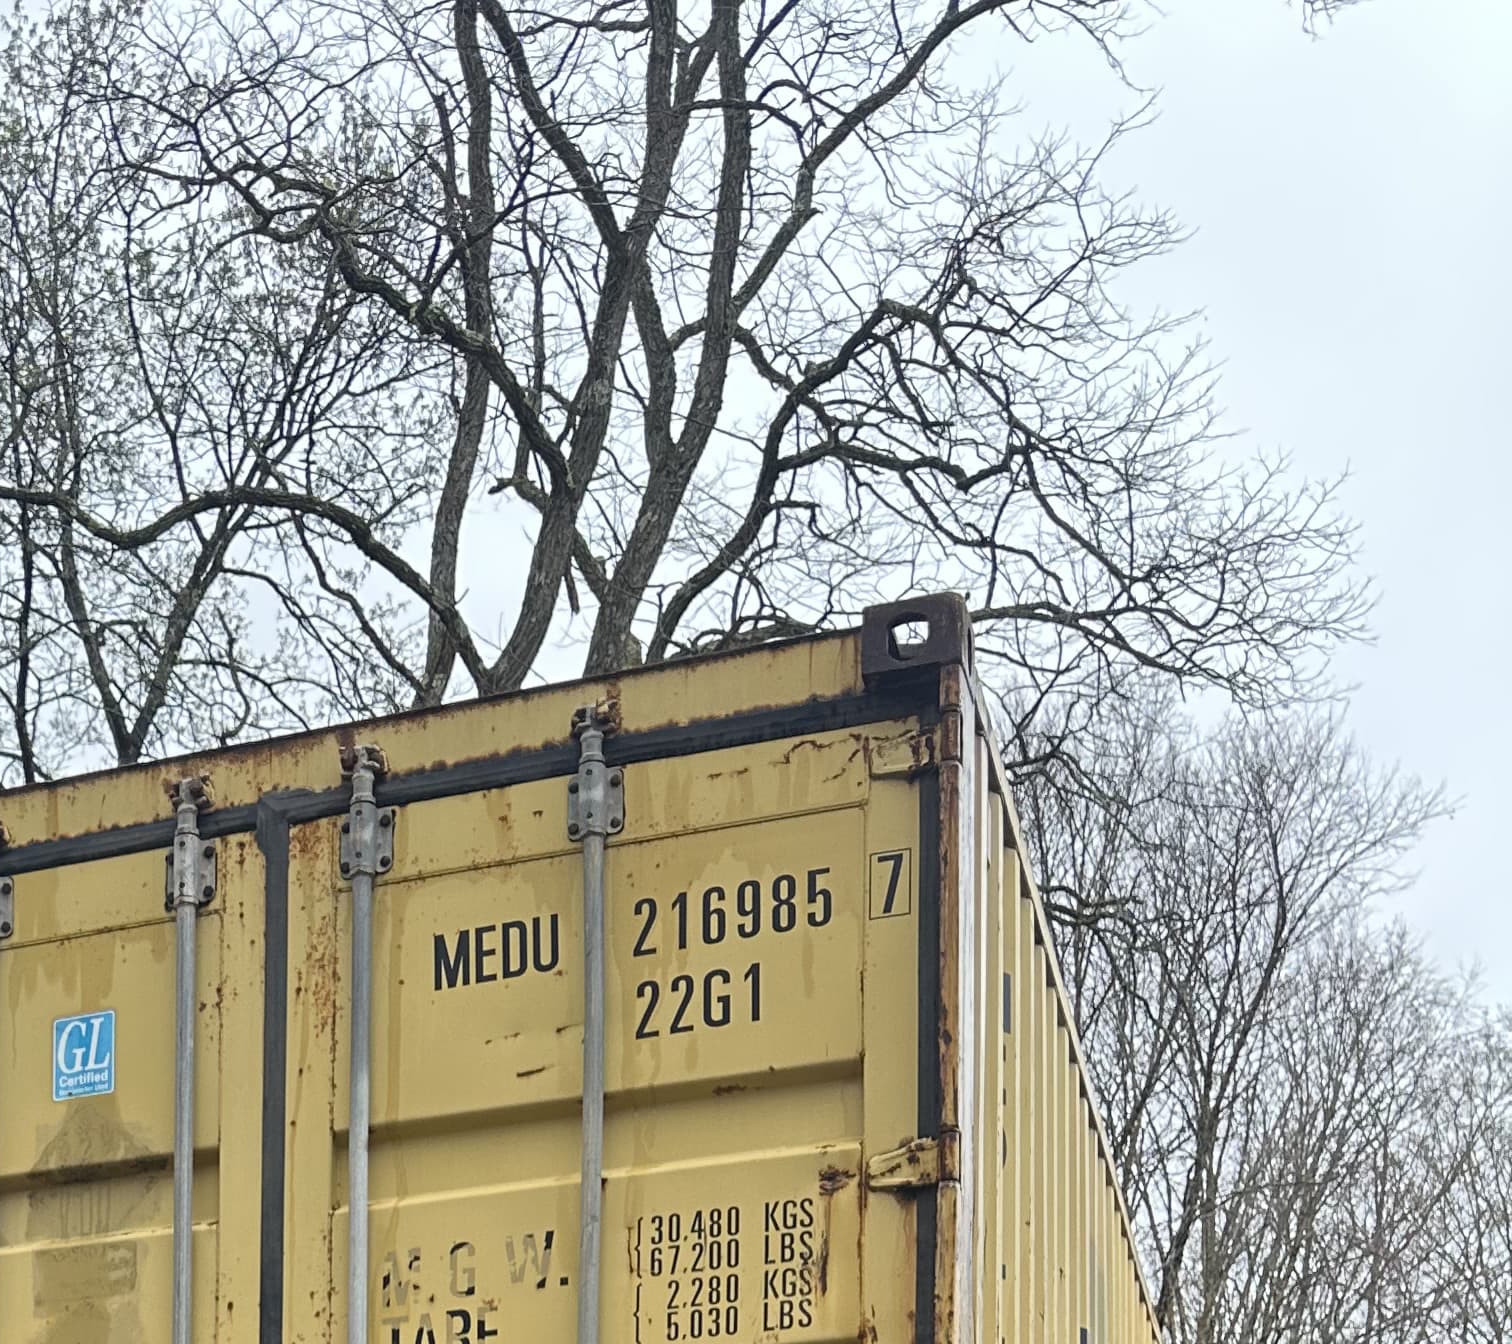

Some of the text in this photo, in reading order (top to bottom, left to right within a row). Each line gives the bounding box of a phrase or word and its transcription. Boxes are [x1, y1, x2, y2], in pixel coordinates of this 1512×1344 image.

[433, 853, 904, 991] MEDU 216985 7
[635, 963, 761, 1041] 22G1
[58, 1017, 110, 1074] GL
[59, 1069, 108, 1088] Certified
[763, 1198, 814, 1233] KGS
[650, 1231, 814, 1277] 67,200 LBS
[666, 1268, 813, 1310] 2,280 KGS
[666, 1299, 813, 1342] 5,030 LBS
